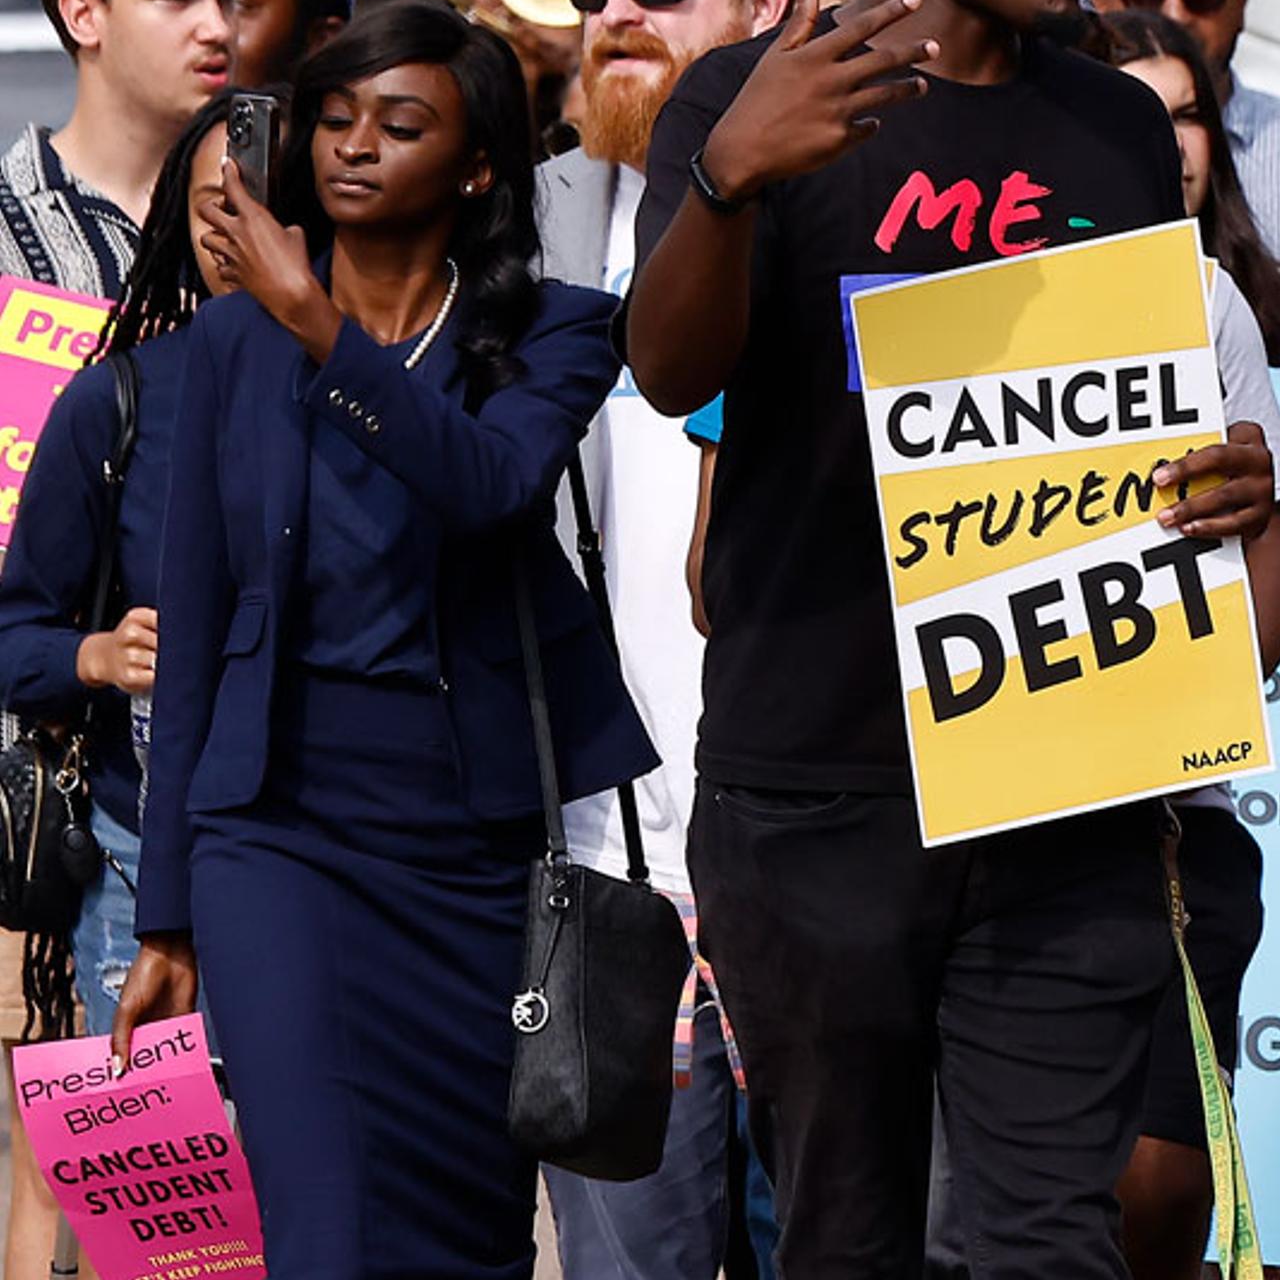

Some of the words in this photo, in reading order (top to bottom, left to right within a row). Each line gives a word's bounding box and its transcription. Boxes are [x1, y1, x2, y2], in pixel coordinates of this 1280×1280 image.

[16, 309, 100, 359] Pre
[886, 362, 1199, 459] CANCEL
[915, 537, 1224, 724] DEBT
[1182, 740, 1253, 772] NAACP
[63, 1085, 172, 1135] Biden:
[53, 1132, 229, 1185] CANCELED
[84, 1168, 234, 1216] STUDENT
[130, 1204, 228, 1242] DEBT!
[148, 1249, 197, 1268] THANK
